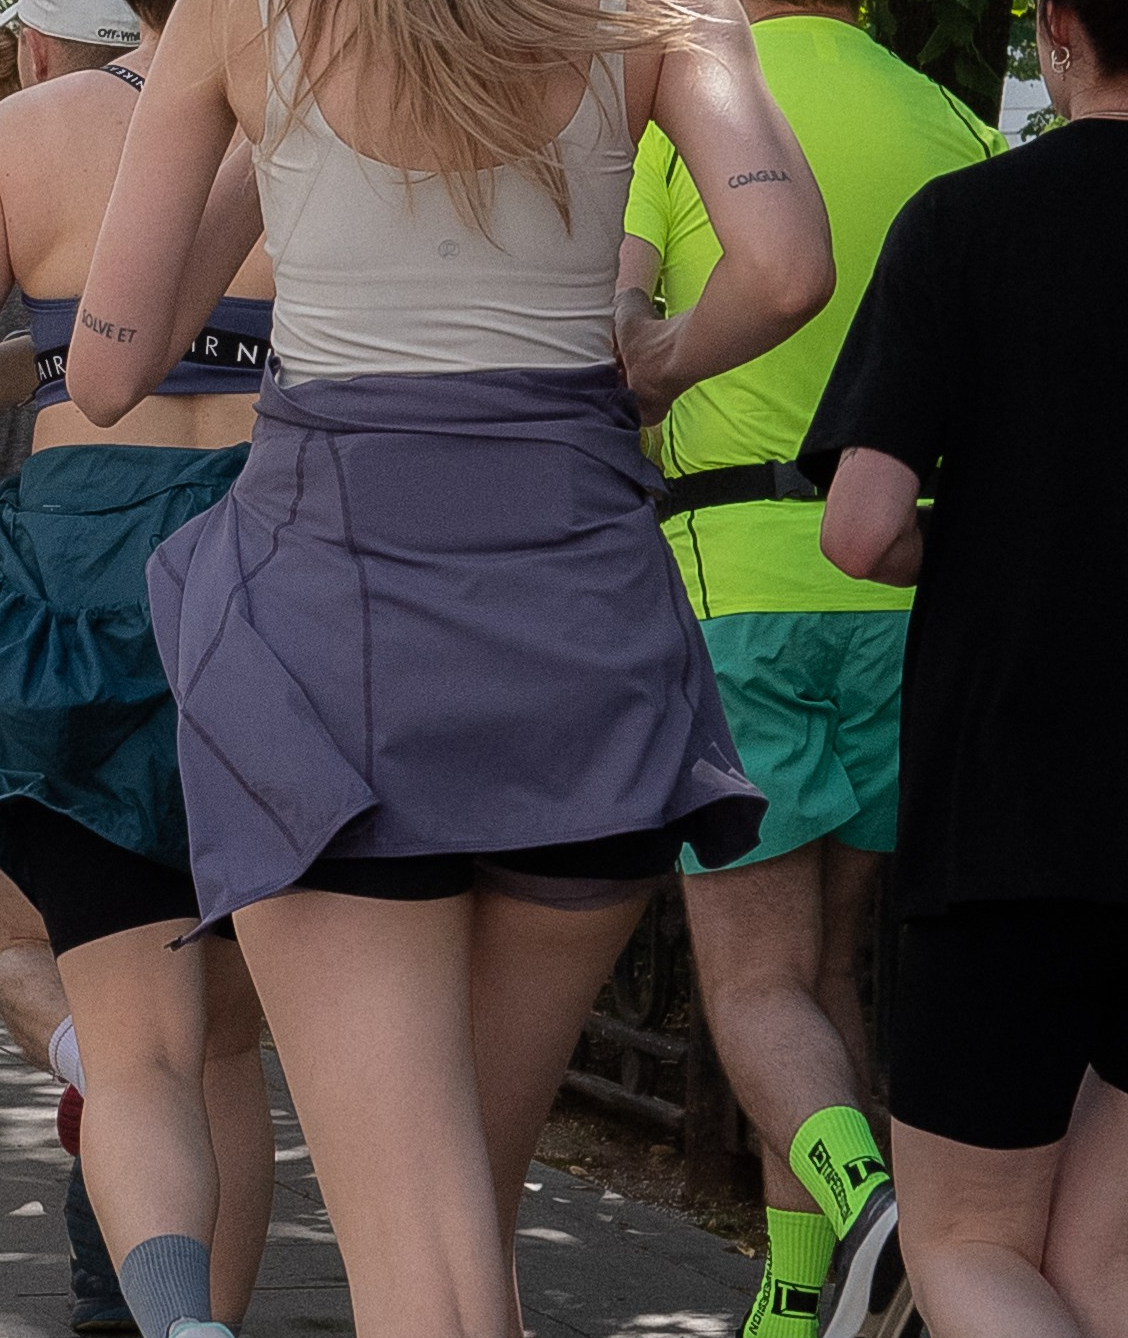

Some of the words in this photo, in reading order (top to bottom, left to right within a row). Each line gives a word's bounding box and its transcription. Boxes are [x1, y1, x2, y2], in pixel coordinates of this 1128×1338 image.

[728, 170, 792, 188] COAGULA
[82, 309, 115, 339] SOLVE
[118, 328, 137, 342] ET
[38, 356, 67, 380] AIR
[192, 336, 218, 357] IR
